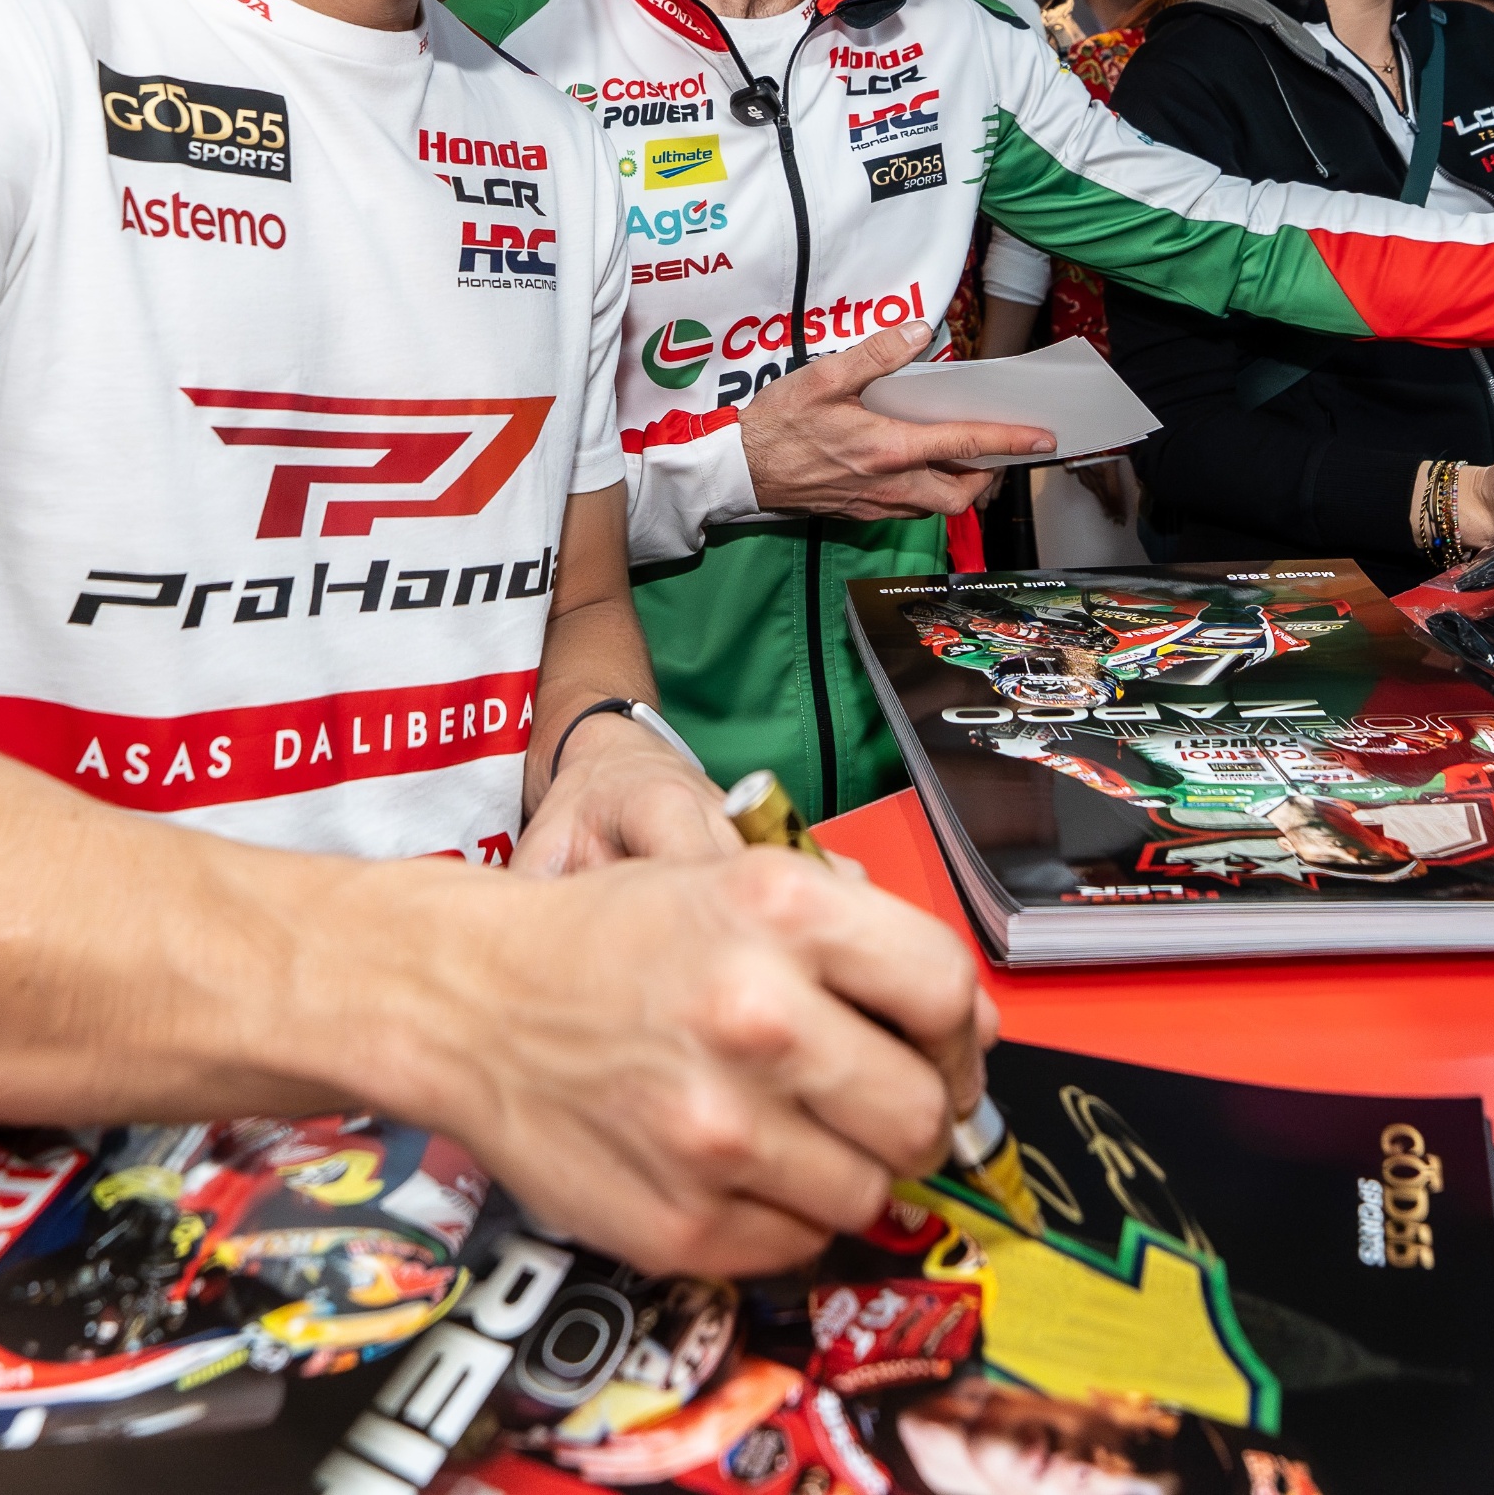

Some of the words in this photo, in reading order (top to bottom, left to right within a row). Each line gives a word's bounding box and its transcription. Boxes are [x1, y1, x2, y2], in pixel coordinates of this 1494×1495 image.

[829, 42, 924, 70] Honda
[602, 71, 707, 102] Castrol
[843, 64, 927, 96] LCR
[603, 98, 714, 130] POWER1
[848, 89, 940, 144] HRC
[418, 128, 548, 171] Honda
[850, 134, 898, 152] Honda
[900, 123, 939, 138] RACING
[187, 141, 285, 172] SPORTS
[652, 147, 713, 165] ultimate
[445, 175, 547, 217] LCR
[904, 172, 943, 190] SPORTS
[121, 186, 288, 251] Astemo
[459, 221, 556, 277] HRC
[457, 276, 512, 289] Honda
[514, 278, 558, 292] RACING
[631, 252, 734, 285] SENA
[721, 281, 925, 360] Castrol
[879, 585, 947, 595] Malaysia
[1023, 580, 1066, 589] Kuala
[1276, 571, 1336, 579] MotoGP
[942, 699, 1327, 724] ZARCO
[75, 735, 233, 786] ASAS
[1181, 749, 1305, 762] Castrol
